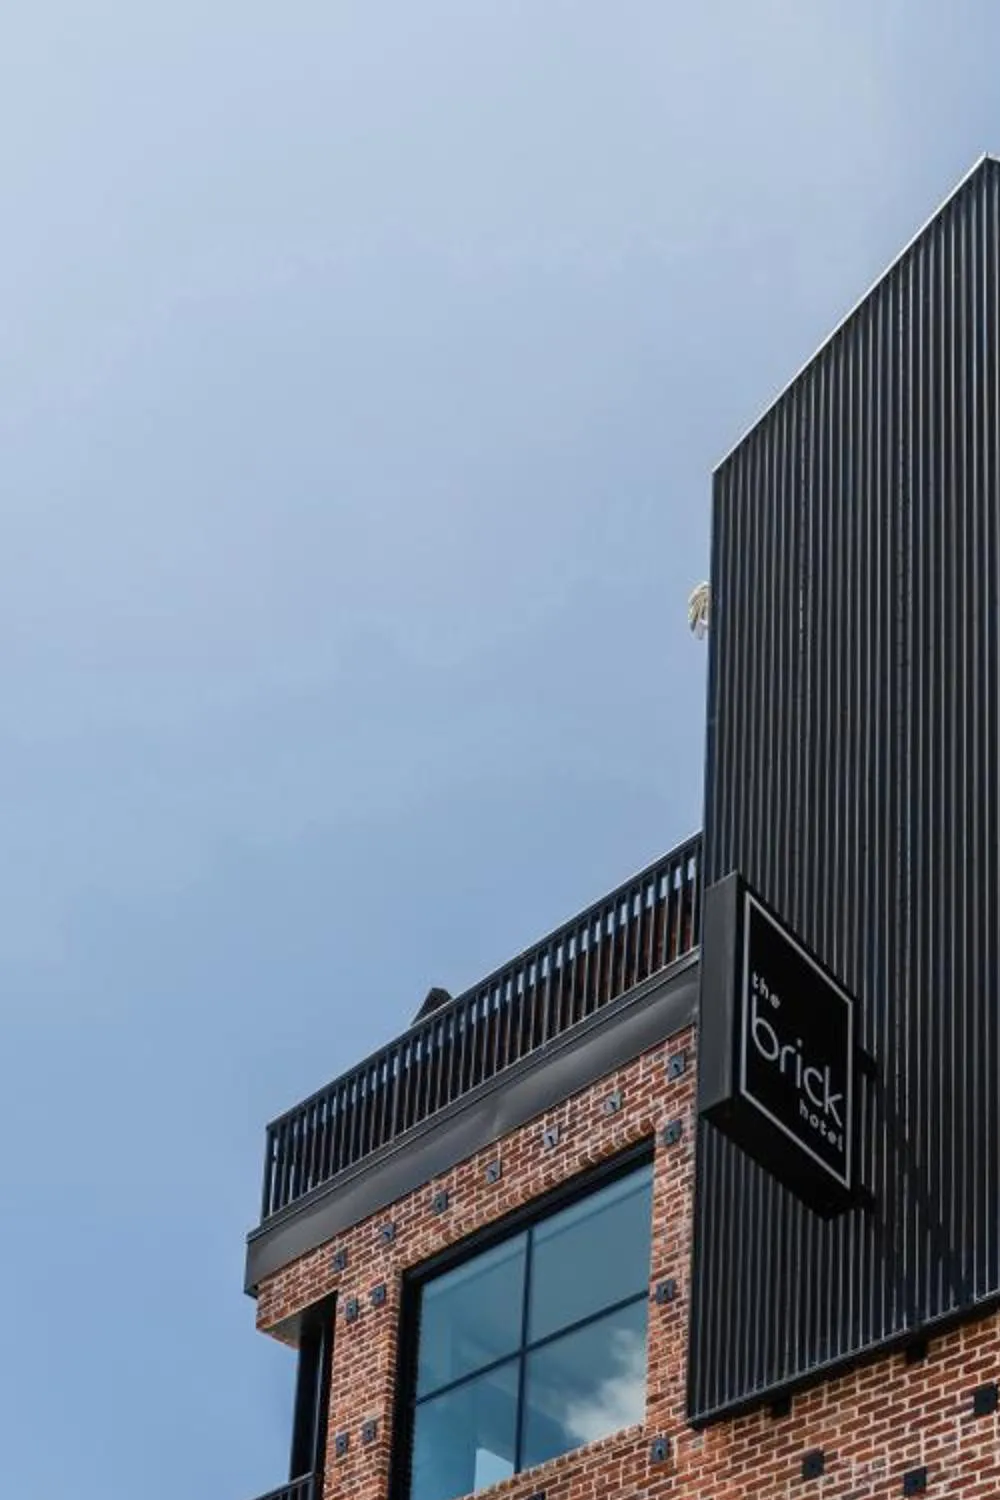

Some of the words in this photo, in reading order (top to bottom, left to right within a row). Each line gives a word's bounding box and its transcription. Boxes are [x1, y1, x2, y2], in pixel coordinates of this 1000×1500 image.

[752, 970, 781, 1009] the
[751, 993, 844, 1128] brick
[799, 1099, 844, 1153] hotel
